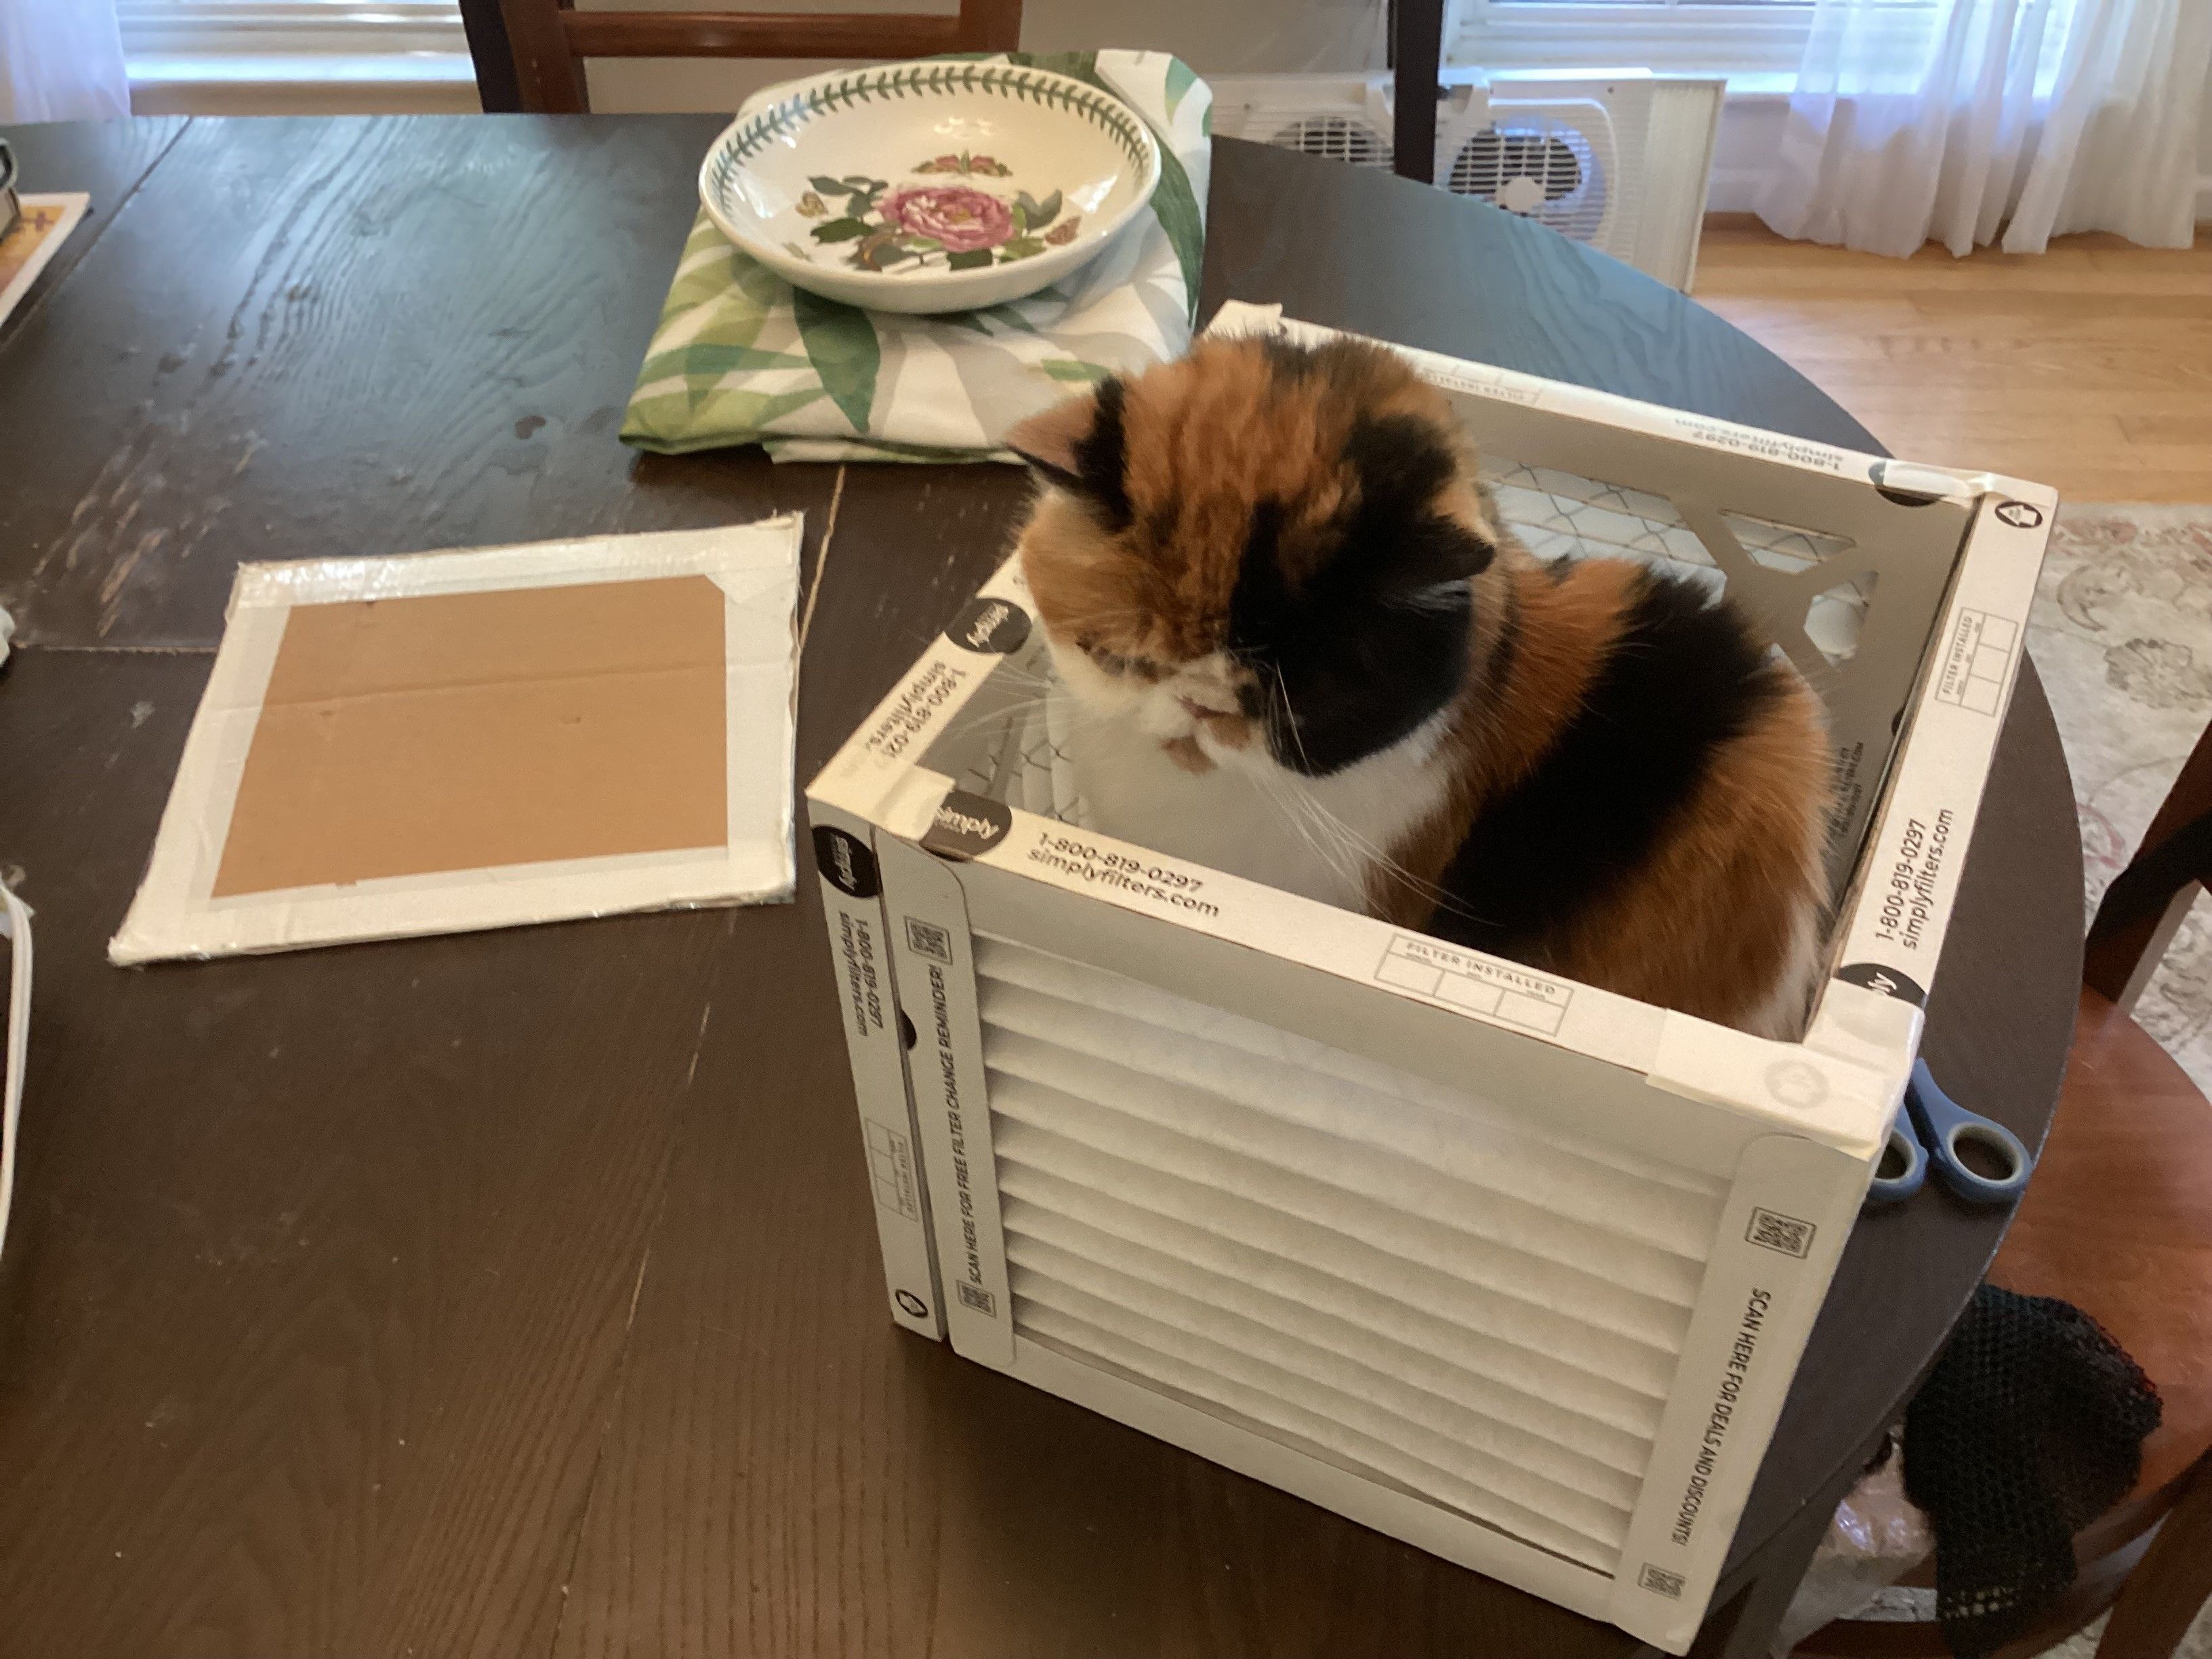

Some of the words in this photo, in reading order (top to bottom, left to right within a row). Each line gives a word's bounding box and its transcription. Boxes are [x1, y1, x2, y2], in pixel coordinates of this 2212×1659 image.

[1942, 661, 1959, 695] FILTER
[1027, 848, 1220, 917] simplyfilters.com
[1039, 831, 1204, 893] 1-800-819-0297
[1875, 817, 1926, 942] 1-800-819-0297
[1902, 808, 1954, 949] simplyfilters.com
[839, 910, 868, 1037] simplyfilters.com
[855, 918, 884, 1029] 1-800-819-0297
[1406, 941, 1460, 966] FILTER
[1467, 960, 1557, 996] INSTALLED
[928, 963, 952, 1050] REMINDER!
[939, 1050, 960, 1110] CHANGE
[948, 1111, 965, 1156] FILTER
[954, 1155, 970, 1190] FREE
[959, 1191, 975, 1218] FOR
[962, 1218, 978, 1253] HERE
[968, 1252, 982, 1284] SCAN
[1742, 1288, 1771, 1334] SCAN
[1729, 1333, 1755, 1372] HERE
[1720, 1372, 1743, 1403] FOR
[1706, 1402, 1732, 1448] DEALS
[1694, 1447, 1718, 1477] AND
[1671, 1473, 1708, 1547] DISCOUNTS!
